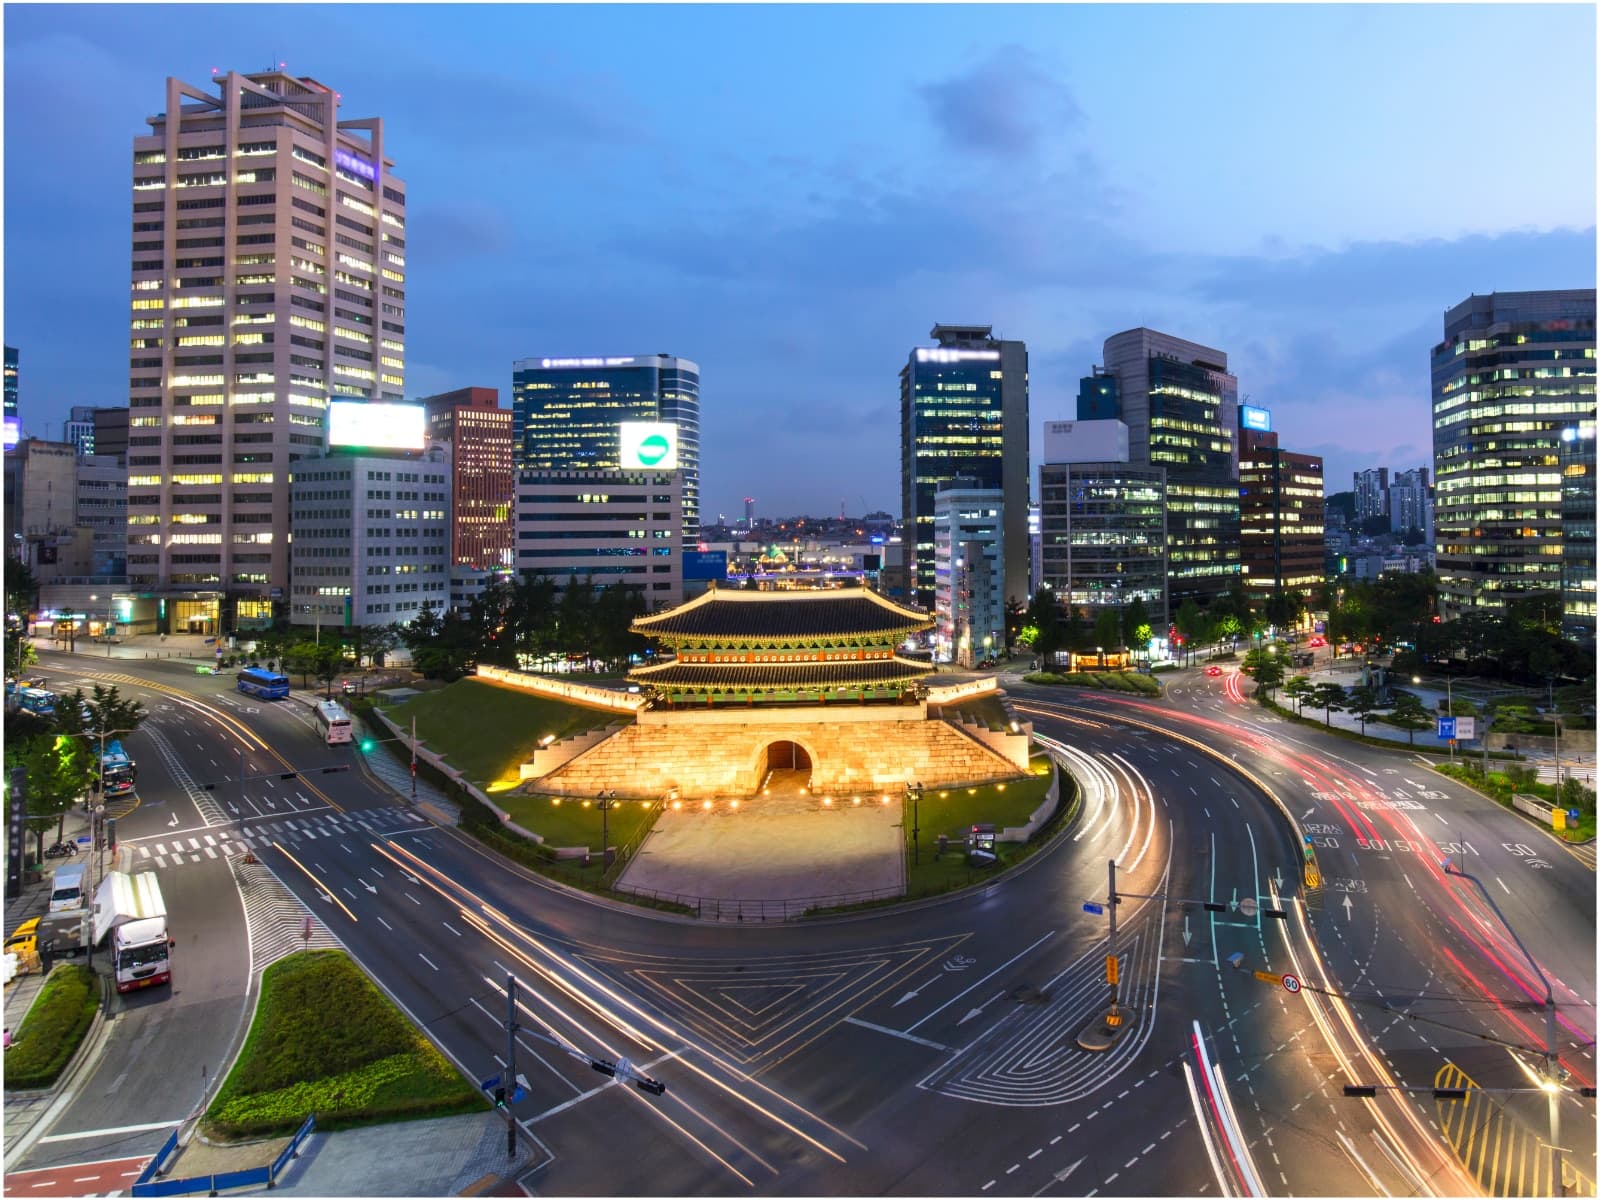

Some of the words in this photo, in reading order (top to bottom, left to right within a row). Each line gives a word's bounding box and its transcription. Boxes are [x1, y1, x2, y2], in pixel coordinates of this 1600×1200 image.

[1314, 836, 1340, 849] 50
[1436, 841, 1468, 855] 50
[1501, 843, 1537, 856] 50
[1286, 978, 1298, 990] 60
